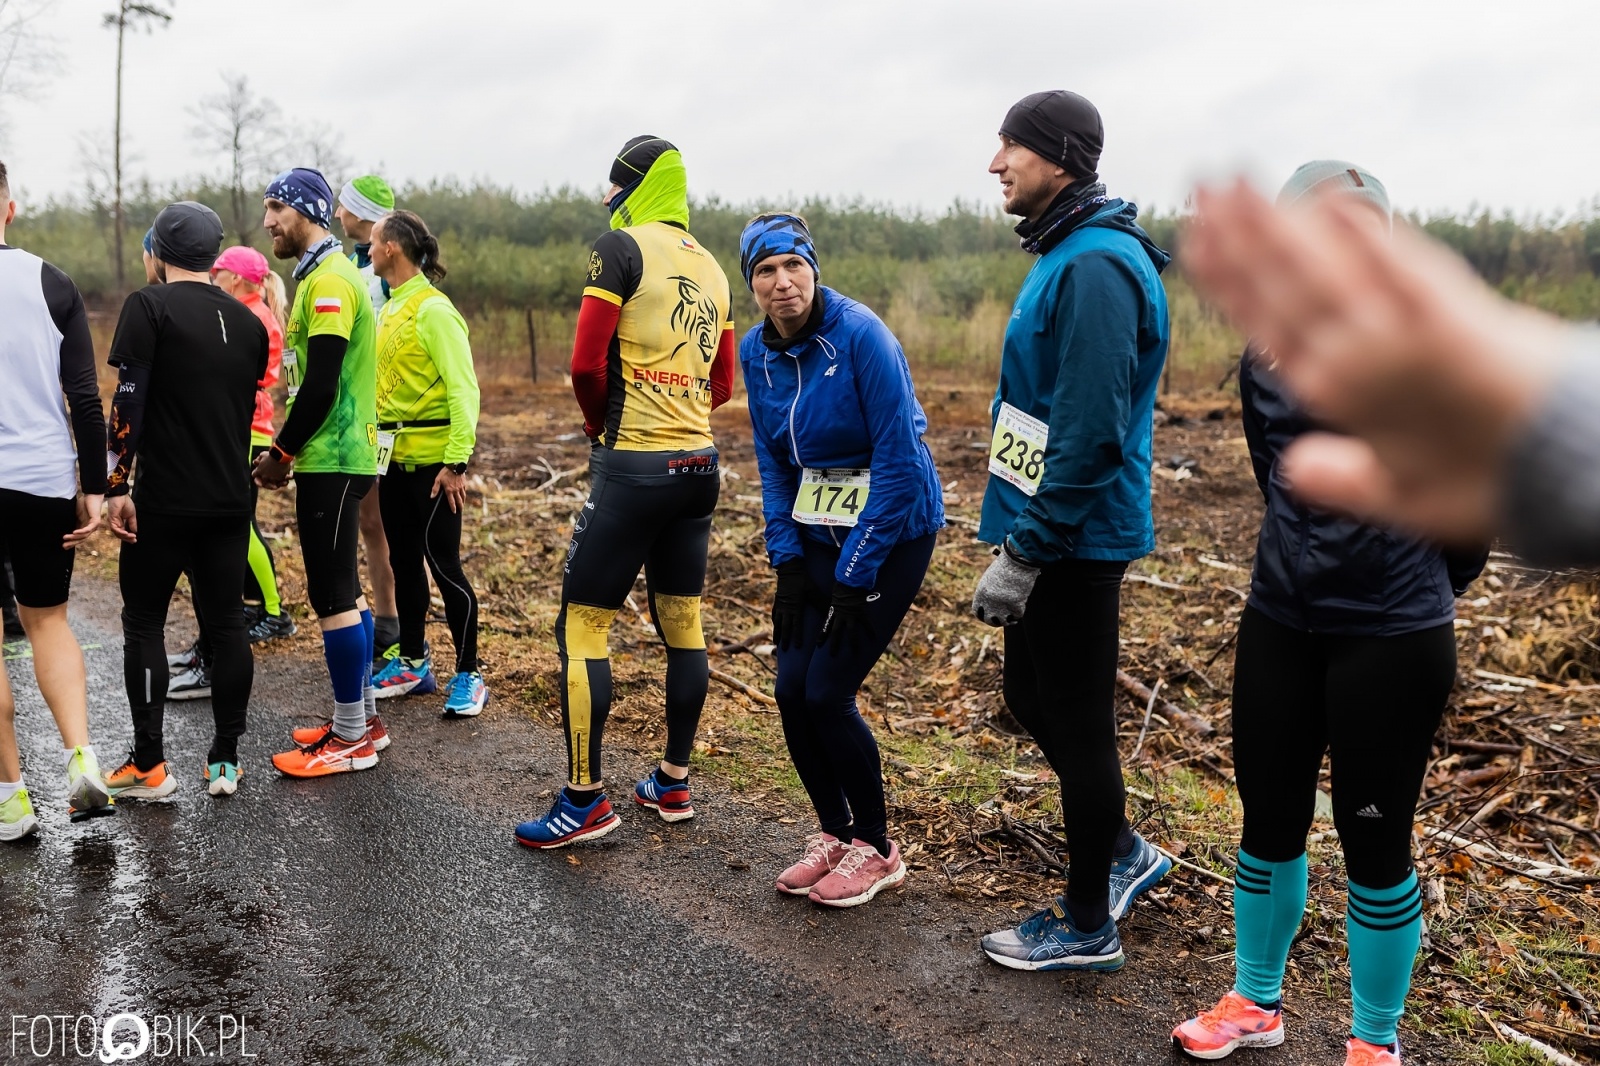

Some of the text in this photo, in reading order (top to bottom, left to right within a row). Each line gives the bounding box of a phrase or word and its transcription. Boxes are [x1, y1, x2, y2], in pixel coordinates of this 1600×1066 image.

[634, 382, 712, 402] BOLATI
[995, 432, 1045, 480] 238
[811, 486, 859, 515] 174
[844, 551, 860, 577] READY
[857, 539, 867, 550] TO
